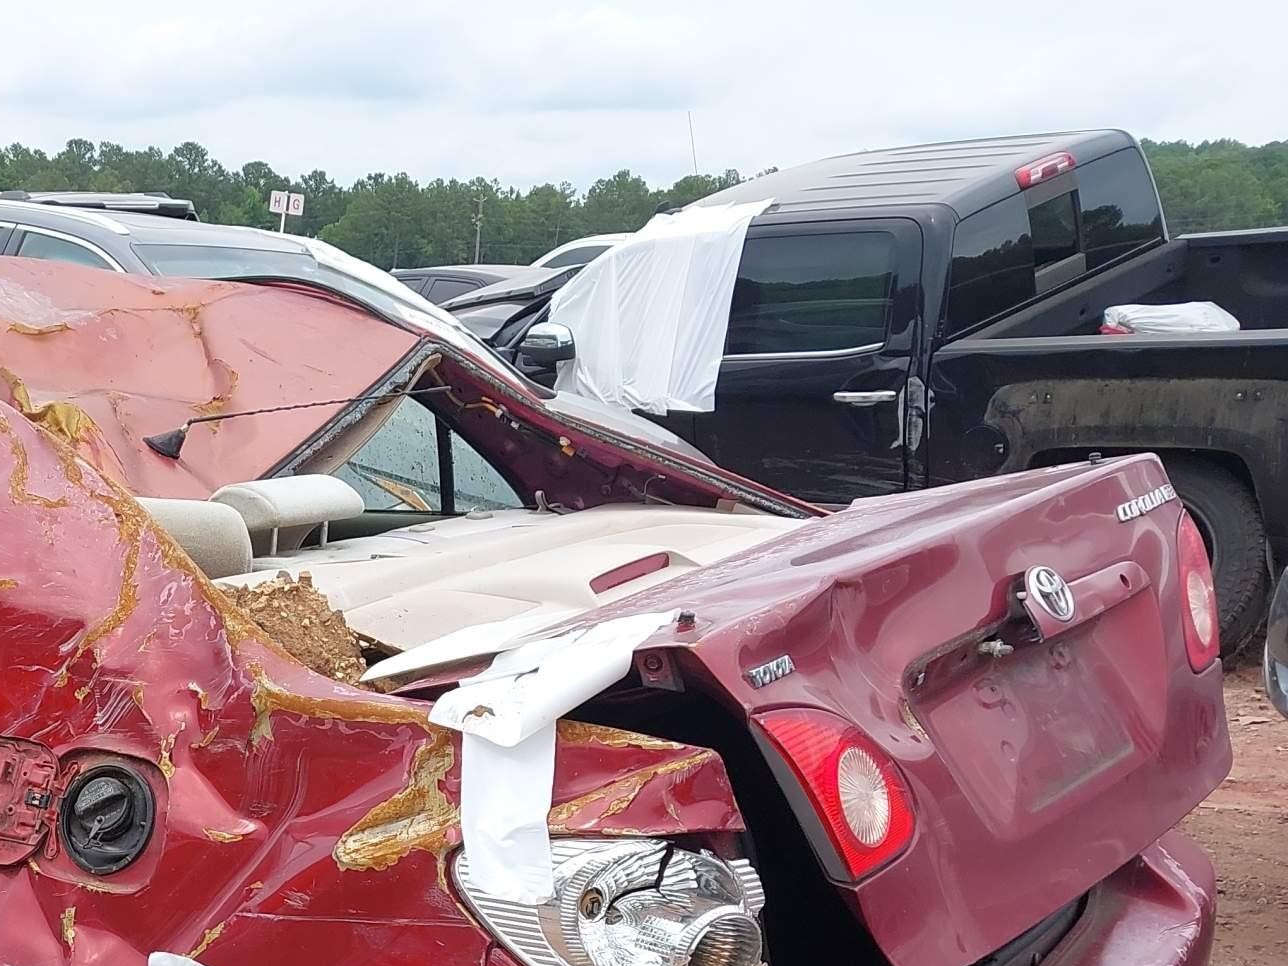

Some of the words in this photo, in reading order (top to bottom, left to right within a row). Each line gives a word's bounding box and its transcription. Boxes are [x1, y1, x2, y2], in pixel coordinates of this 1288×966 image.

[274, 196, 281, 208] H
[292, 198, 301, 210] G
[1116, 488, 1166, 521] COROLLA
[746, 653, 796, 688] TOYOTA
